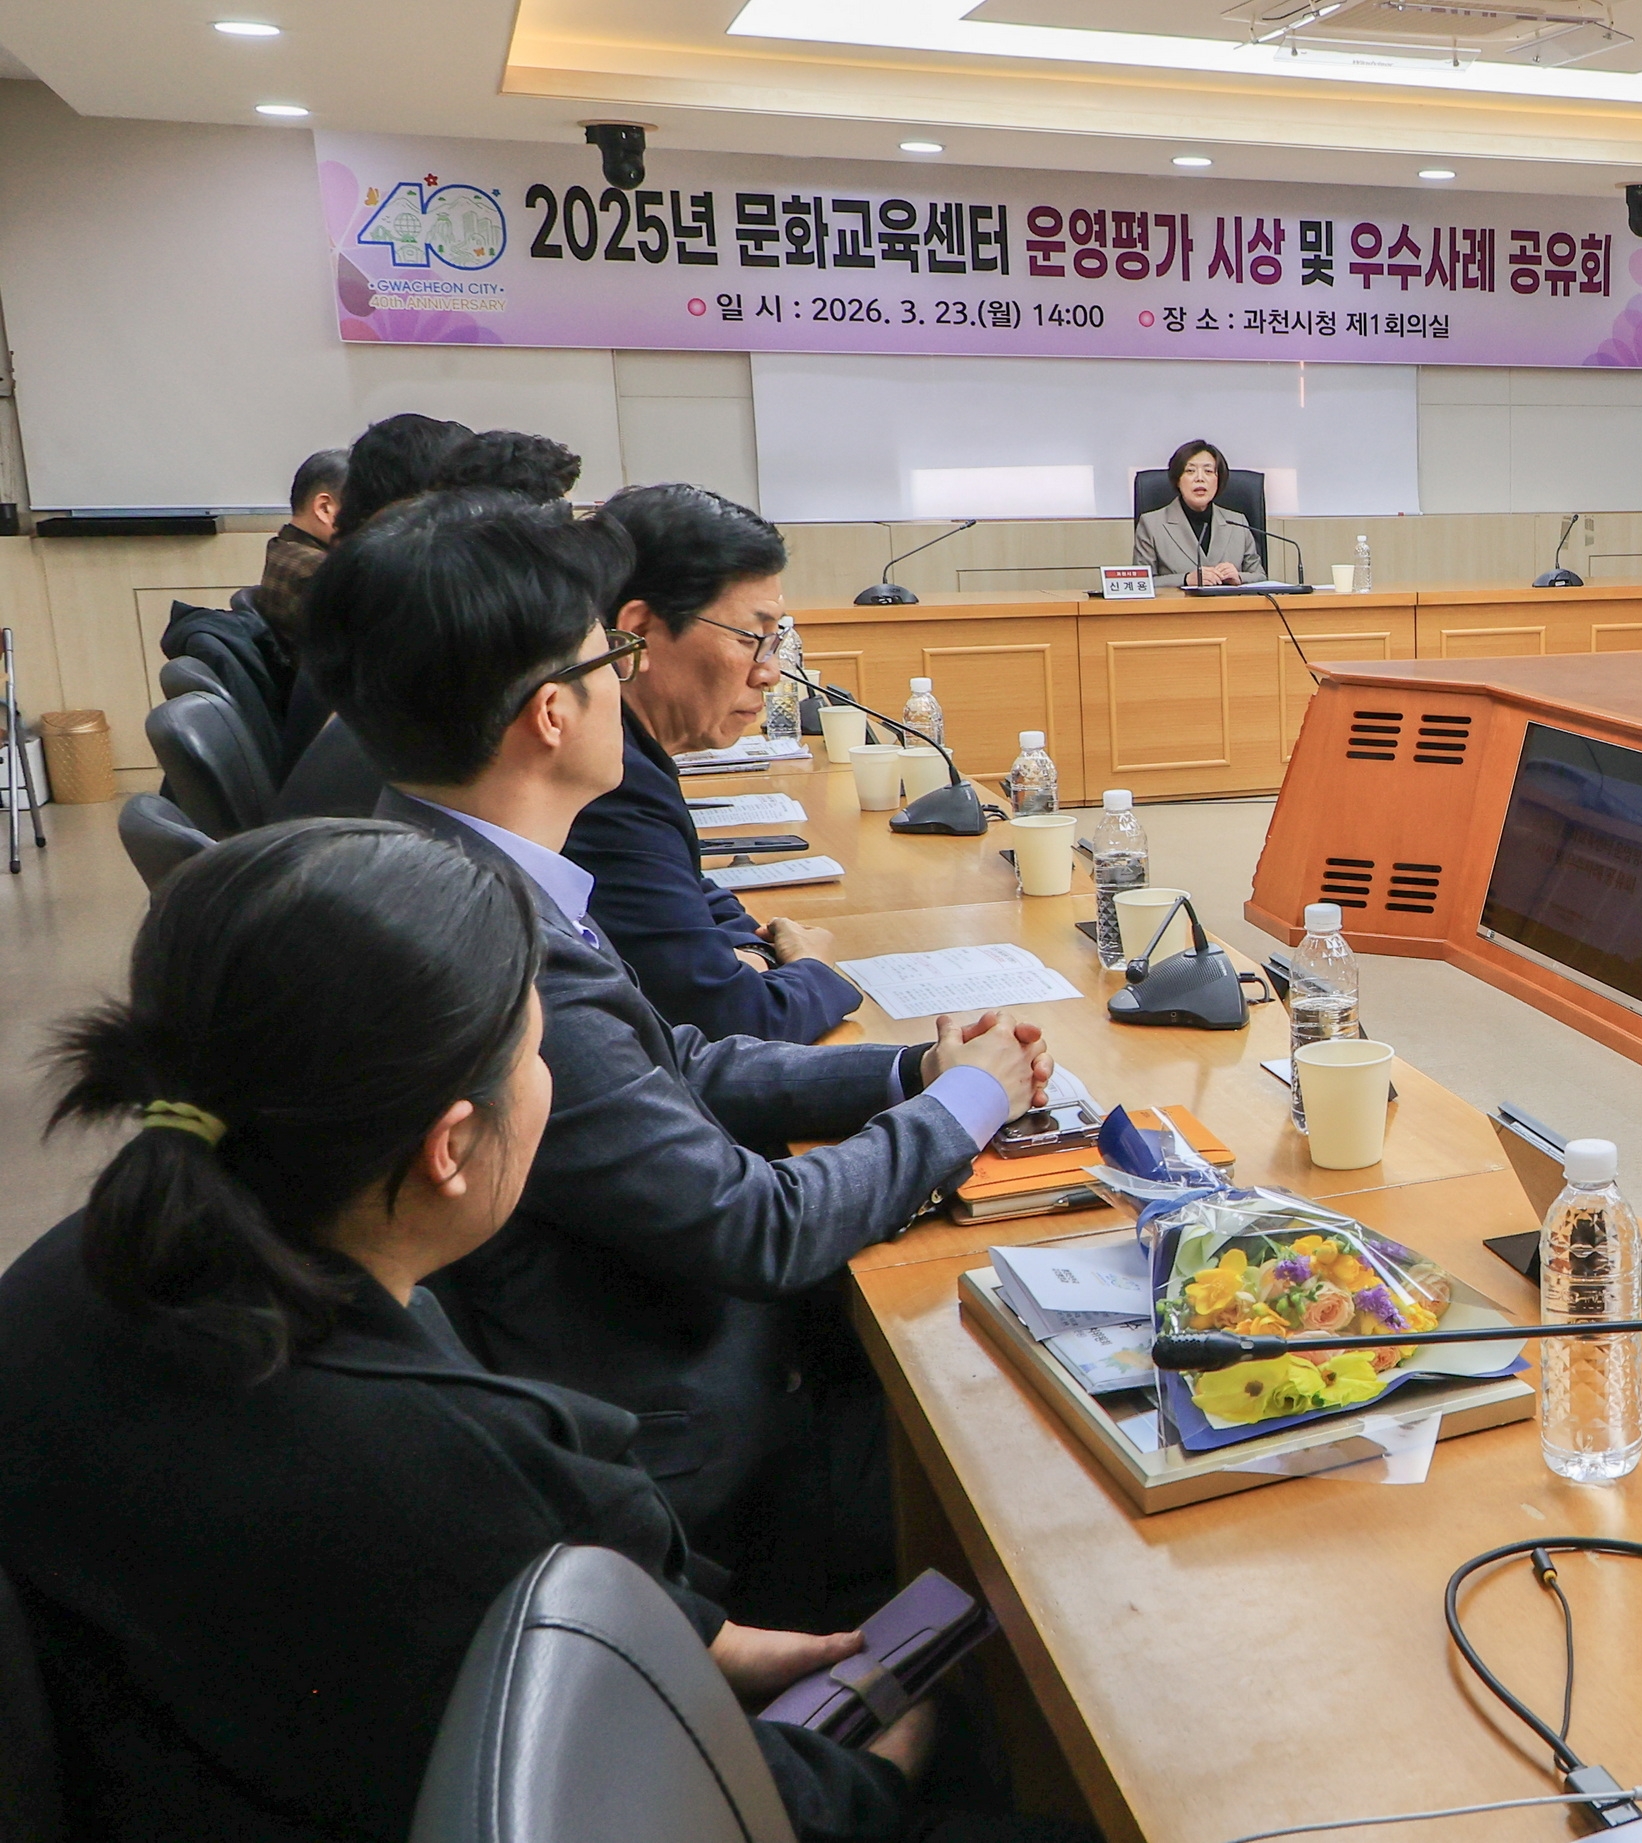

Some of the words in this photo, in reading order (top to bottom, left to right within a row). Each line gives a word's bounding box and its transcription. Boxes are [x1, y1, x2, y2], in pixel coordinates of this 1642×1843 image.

[525, 183, 721, 267] 2025년
[735, 192, 1010, 277] 문화교육센터
[1025, 204, 1194, 283] 운영평가
[1207, 215, 1286, 286] 시상
[1299, 219, 1335, 288] 및
[1348, 221, 1497, 293] 우수사례
[1508, 228, 1612, 297] 공유회
[377, 279, 464, 295] GWACHEON
[466, 281, 499, 295] CITY
[405, 296, 507, 312] ANNIVERSARY
[811, 297, 891, 325] 2026.
[900, 299, 925, 325] 3.
[934, 299, 1022, 328] 23.(월)
[1033, 303, 1105, 328] 14:00
[1242, 308, 1337, 336] 과천시청
[1345, 311, 1450, 339] 제1회의실
